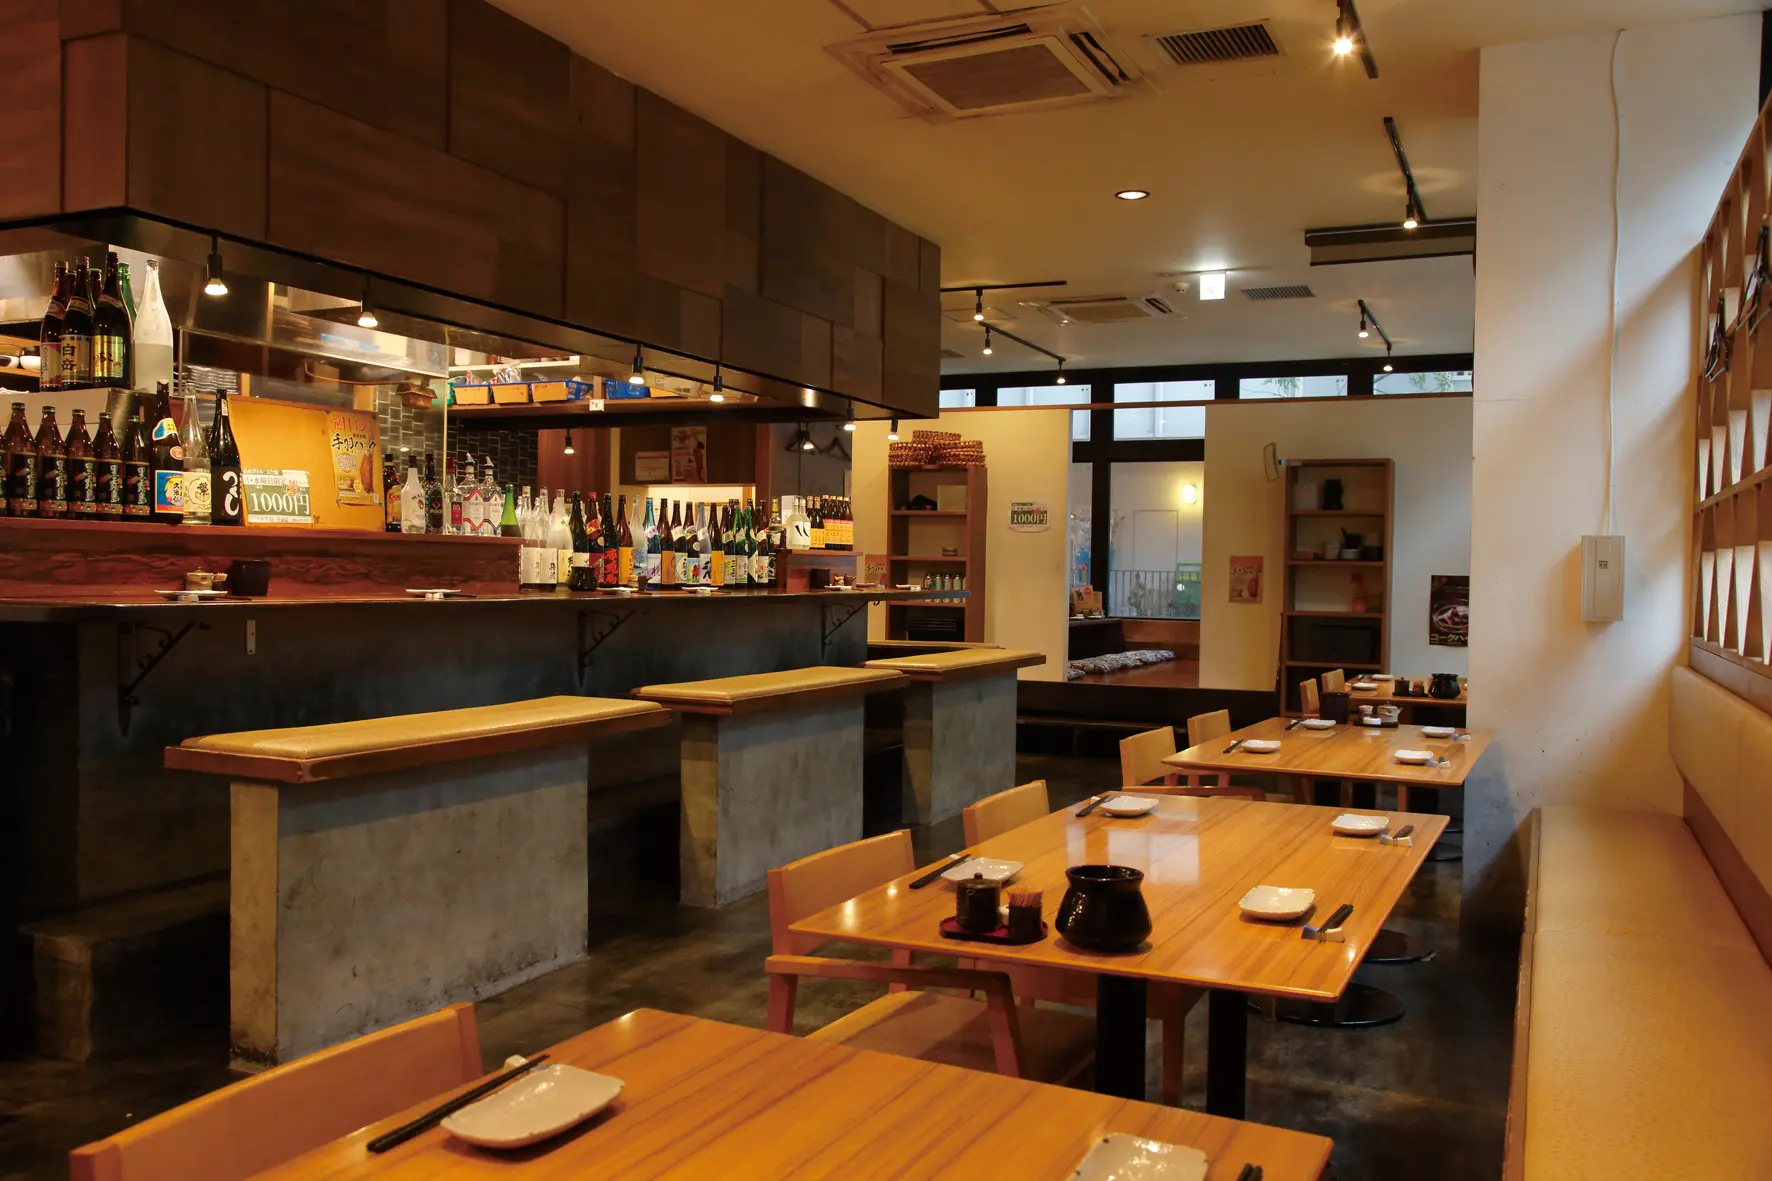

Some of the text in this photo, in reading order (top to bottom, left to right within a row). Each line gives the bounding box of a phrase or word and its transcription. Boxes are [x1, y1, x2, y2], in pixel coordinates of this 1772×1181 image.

[222, 470, 240, 516] つくし
[249, 492, 310, 516] 1000円
[1013, 513, 1047, 524] 1000円
